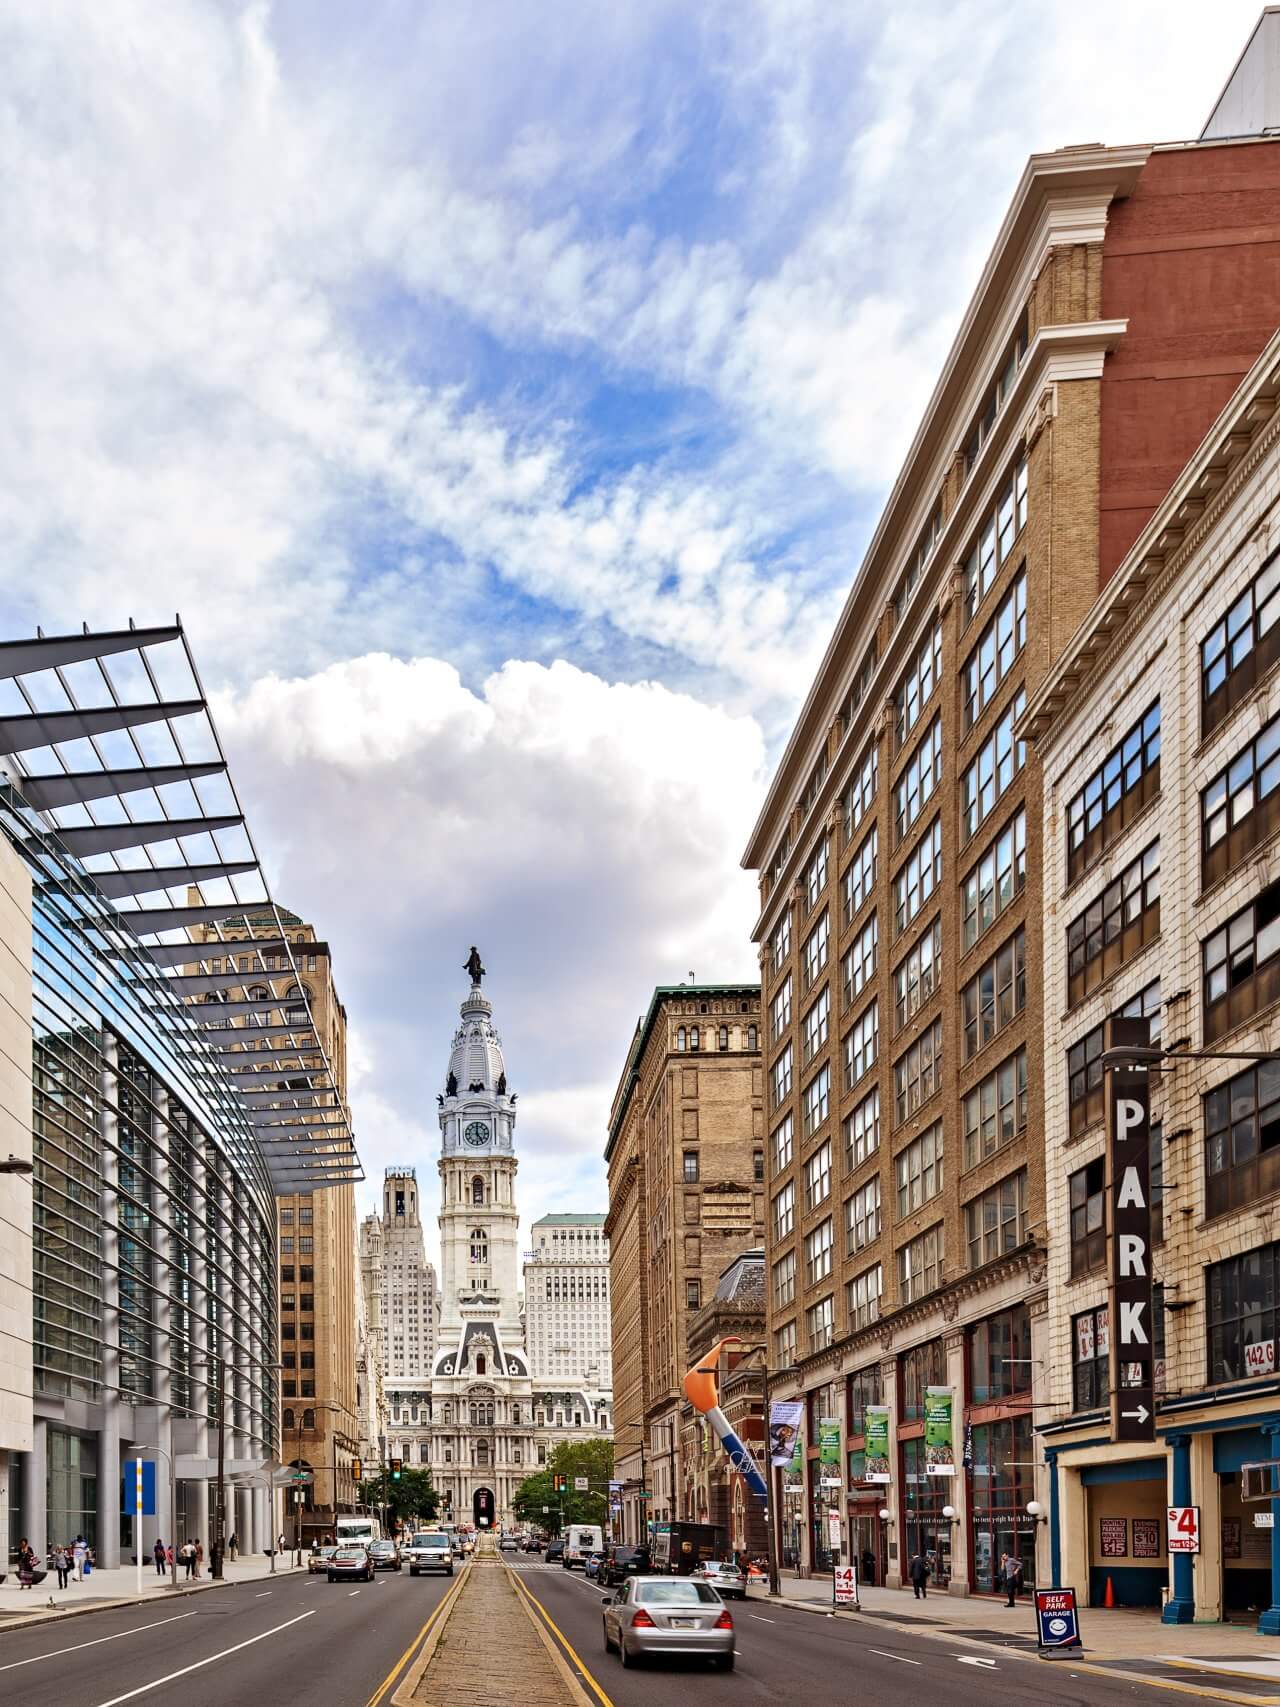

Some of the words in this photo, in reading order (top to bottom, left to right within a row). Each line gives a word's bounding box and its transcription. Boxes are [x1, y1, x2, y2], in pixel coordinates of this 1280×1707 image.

[1116, 1099, 1149, 1344] PARK
[1245, 1345, 1265, 1366] 142
[1169, 1508, 1197, 1536] $4
[1135, 1532, 1157, 1545] $10
[1104, 1541, 1125, 1553] $15
[836, 1568, 853, 1582] $4
[1045, 1595, 1065, 1603] SELF
[1045, 1602, 1067, 1610] PARK
[1043, 1610, 1071, 1618] GARAGE
